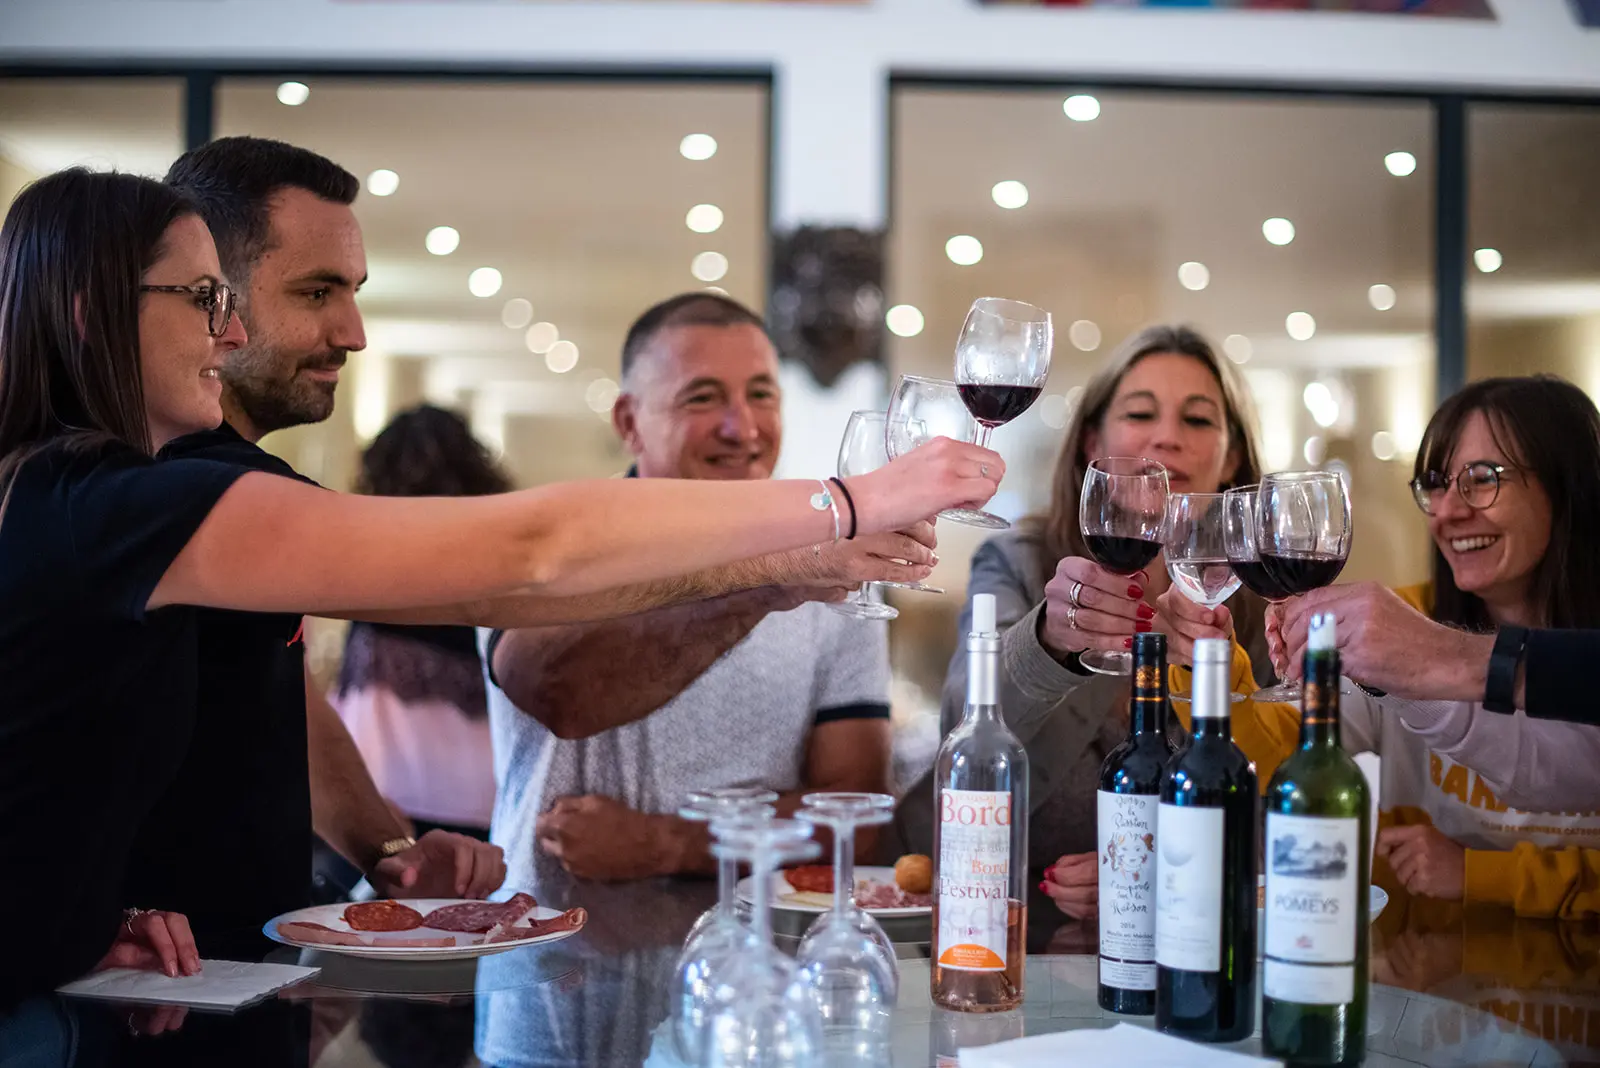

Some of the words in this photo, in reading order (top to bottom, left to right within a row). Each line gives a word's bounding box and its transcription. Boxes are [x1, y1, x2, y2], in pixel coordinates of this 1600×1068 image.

[941, 793, 1011, 826] Bord
[971, 858, 1008, 875] Bord
[1275, 895, 1340, 915] POMEYS
